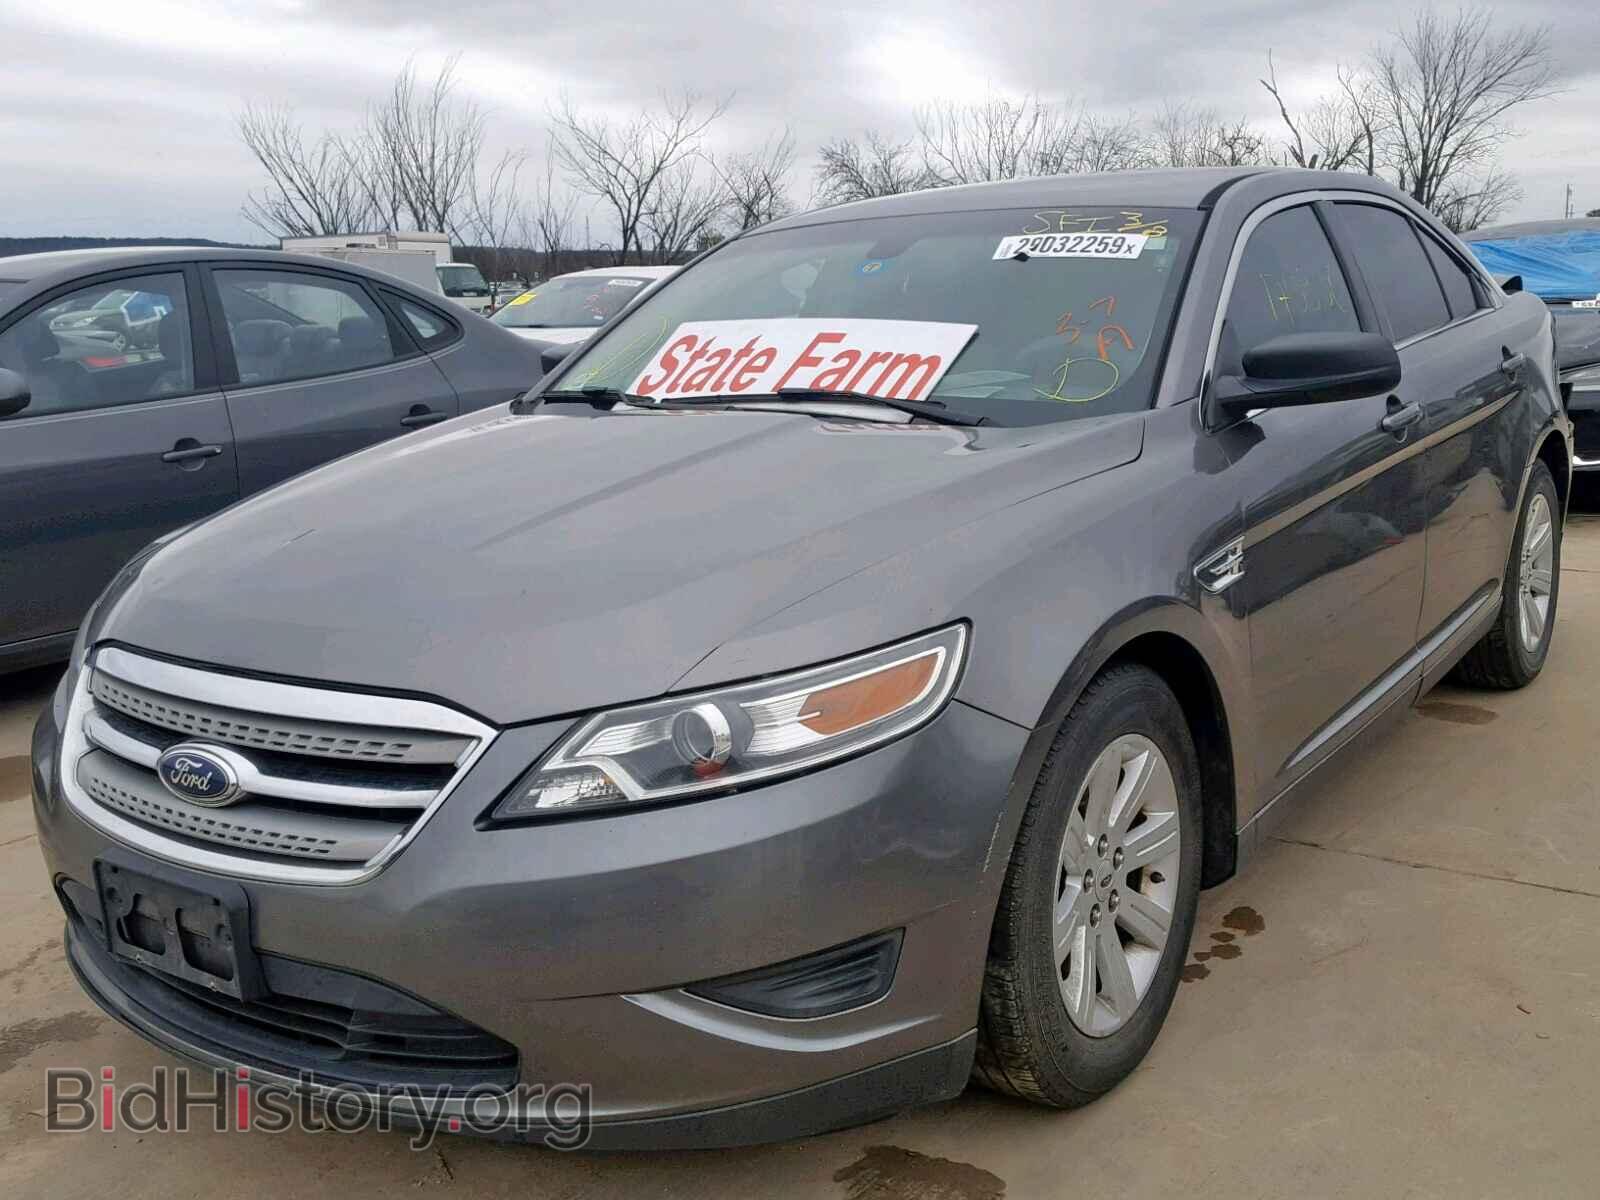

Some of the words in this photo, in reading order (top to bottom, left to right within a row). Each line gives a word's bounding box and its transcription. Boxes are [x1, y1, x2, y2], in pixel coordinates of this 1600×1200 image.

[636, 333, 779, 396] State
[776, 331, 942, 401] Farm
[170, 757, 213, 791] Ford
